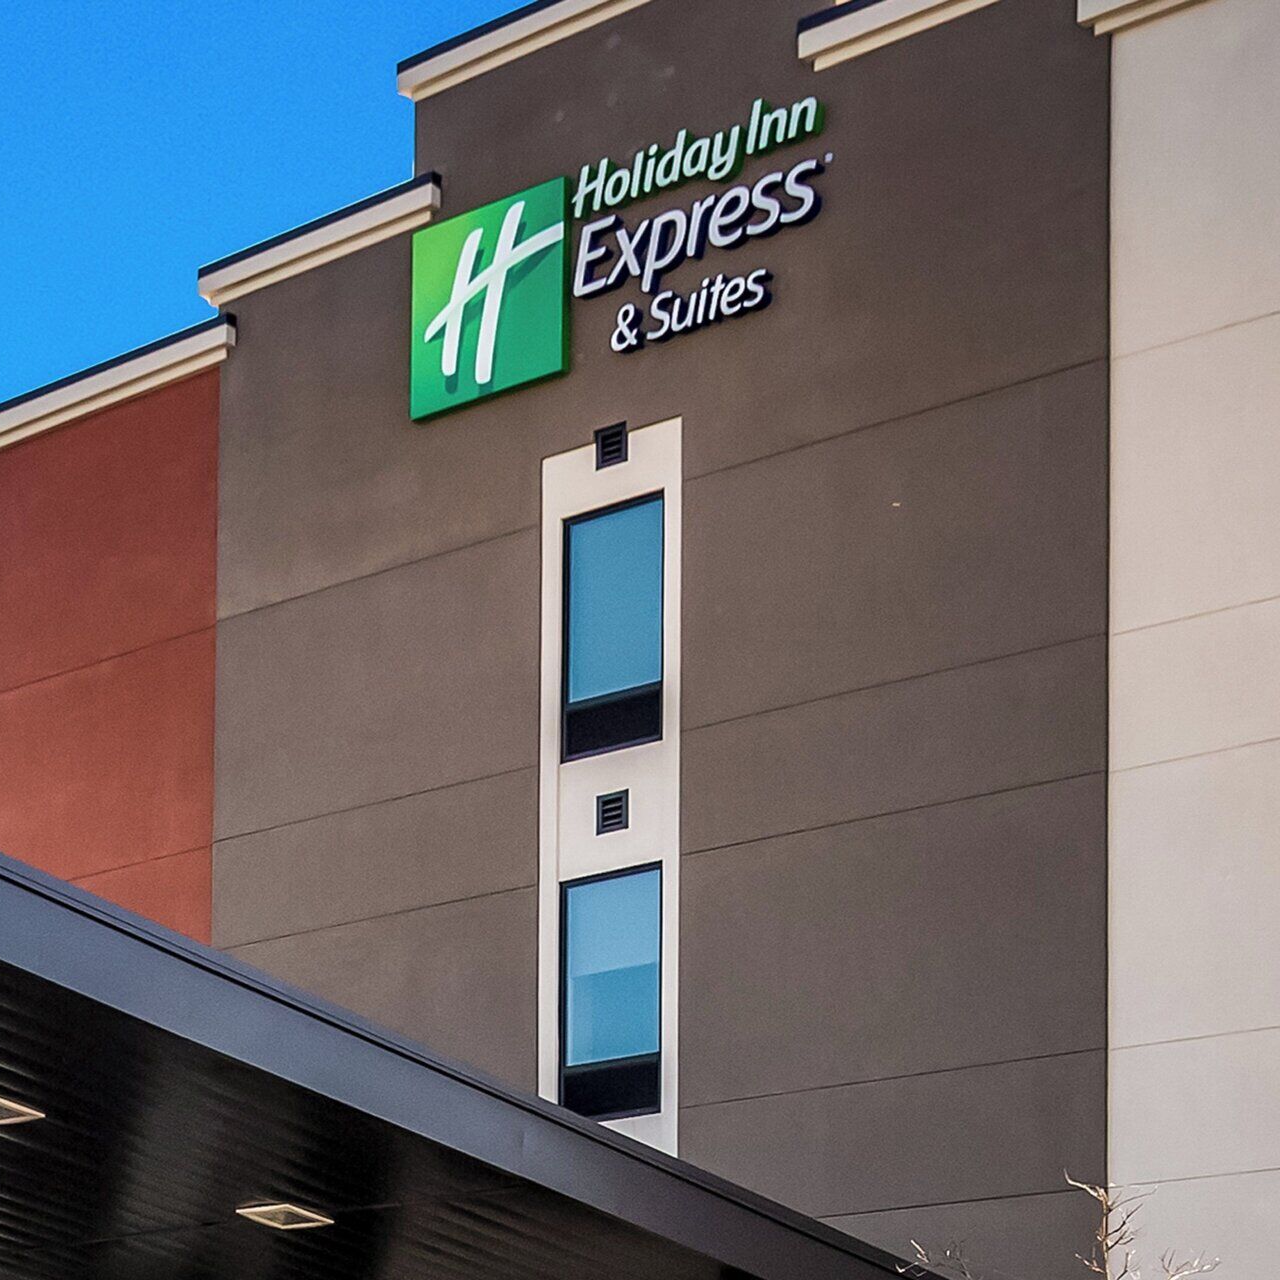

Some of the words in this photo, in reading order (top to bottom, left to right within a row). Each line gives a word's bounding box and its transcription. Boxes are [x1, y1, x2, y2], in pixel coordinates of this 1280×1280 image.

[573, 125, 740, 218] Holiday
[746, 96, 818, 154] Inn
[573, 159, 818, 297] Express
[610, 303, 639, 351] &
[646, 268, 767, 340] Suites
